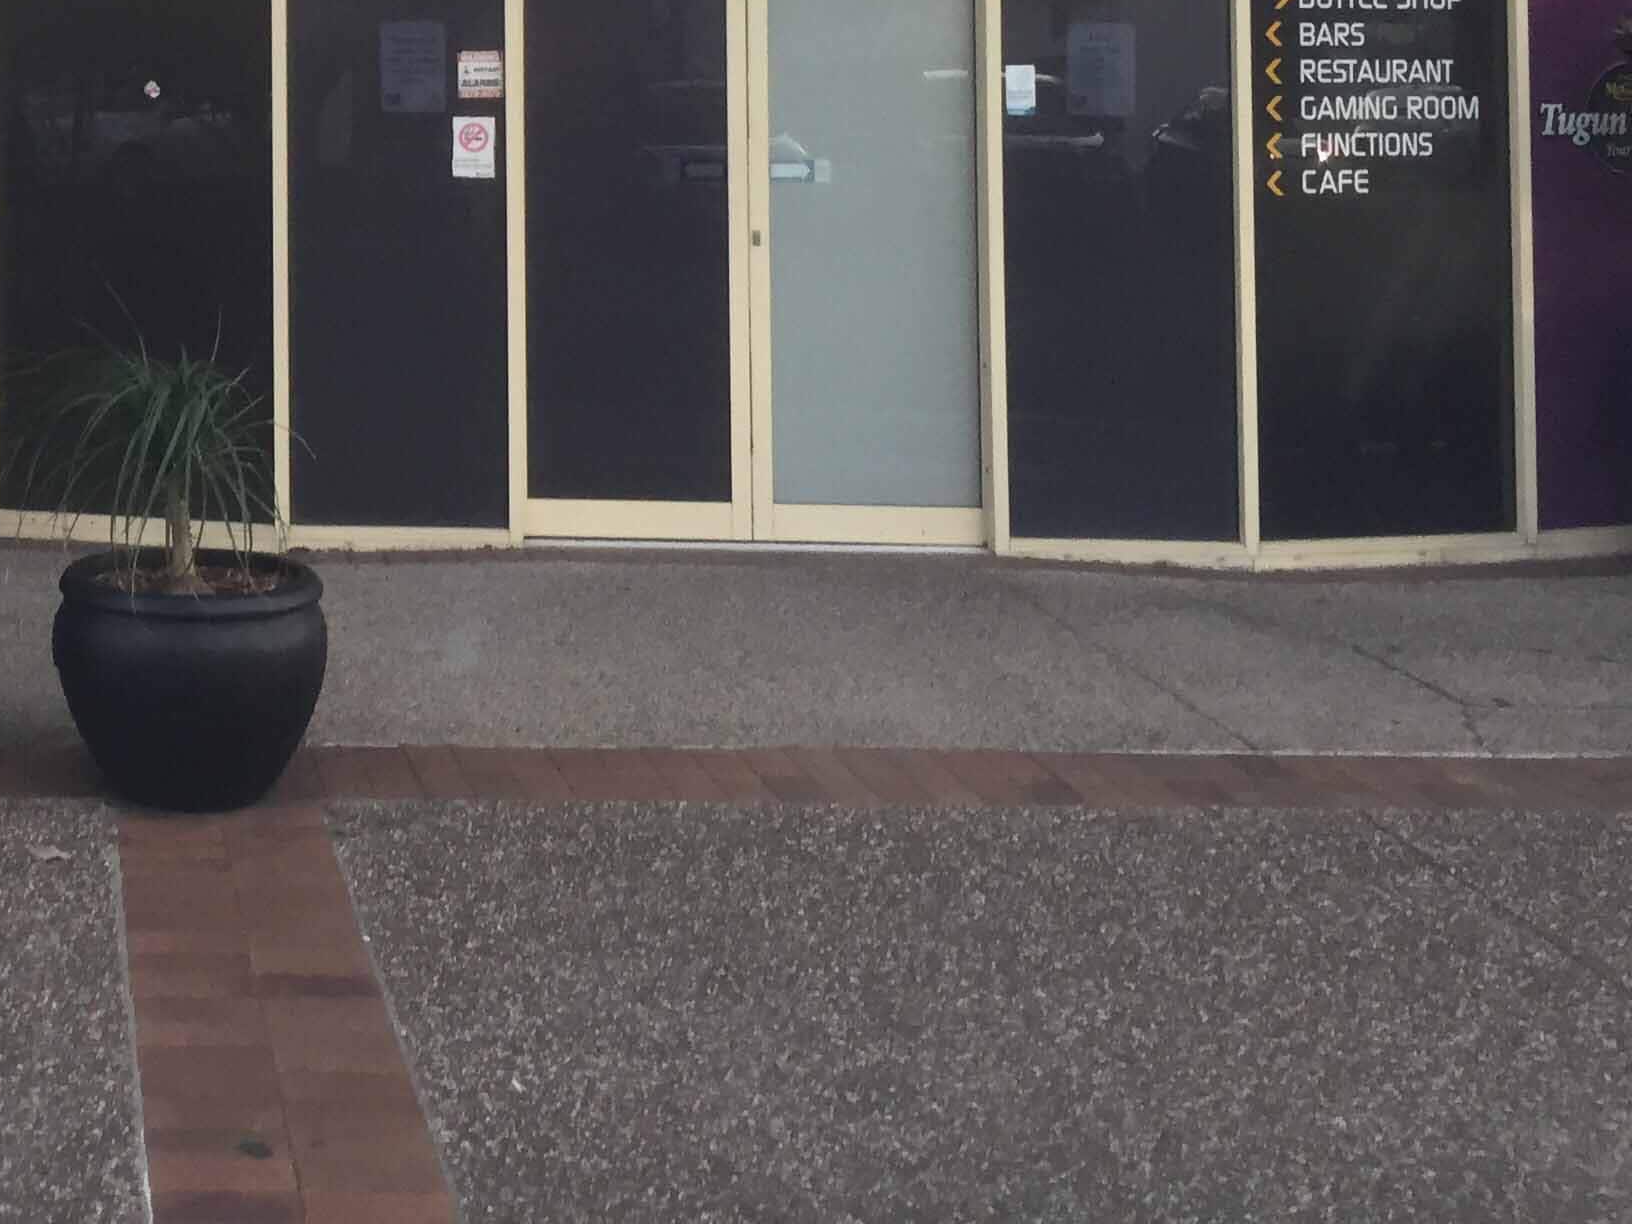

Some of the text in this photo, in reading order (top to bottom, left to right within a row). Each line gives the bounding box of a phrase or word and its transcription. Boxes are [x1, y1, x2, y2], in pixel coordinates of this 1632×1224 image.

[1299, 22, 1366, 47] BARS
[1299, 58, 1454, 84] RESTAURANT
[1300, 95, 1481, 121] GAMING ROOM
[1540, 103, 1628, 146] Tugun
[1300, 131, 1434, 158] FUNCTIONS
[1301, 168, 1370, 194] CAFE
